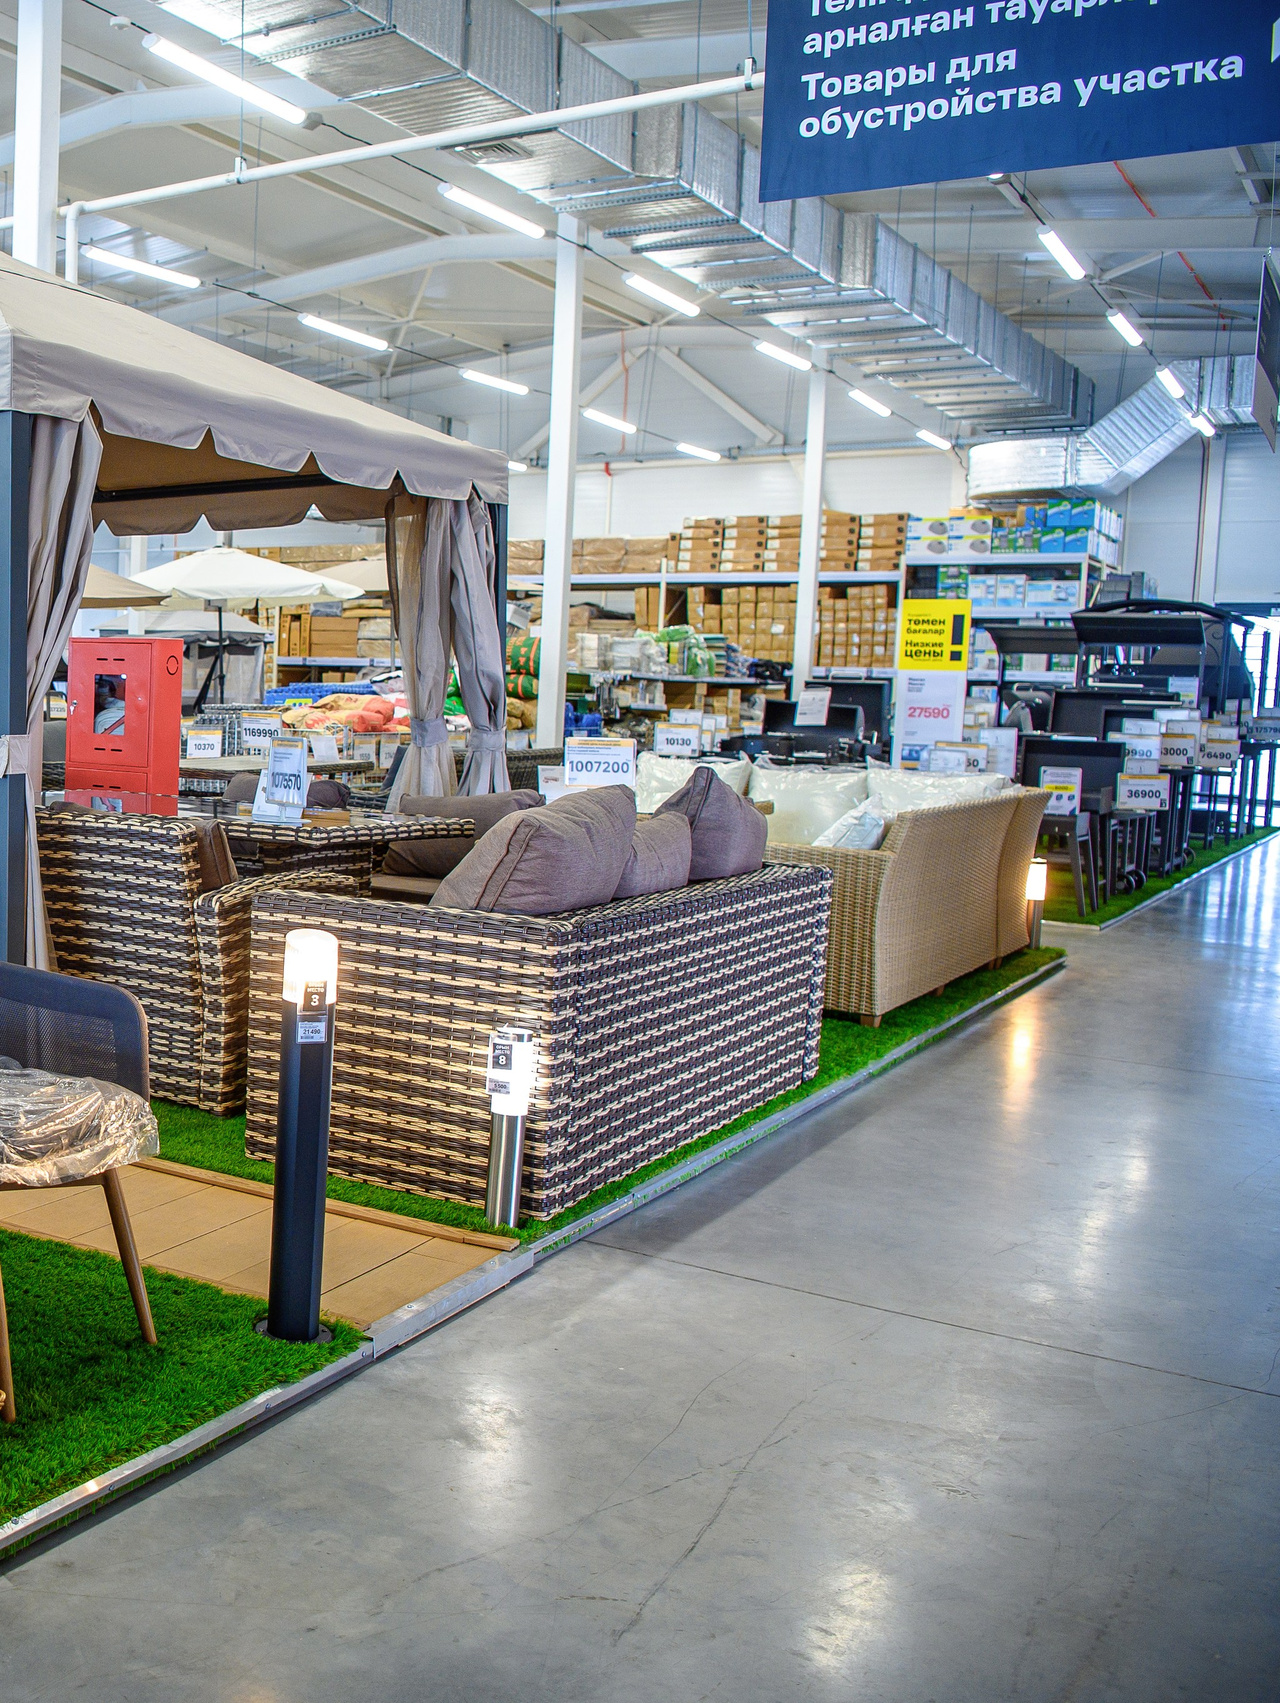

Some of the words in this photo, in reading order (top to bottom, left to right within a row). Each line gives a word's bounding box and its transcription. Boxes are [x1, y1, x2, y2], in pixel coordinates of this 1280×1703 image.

[802, 6, 974, 58] арналған
[984, 0, 1158, 25] тауар
[800, 61, 936, 101] Товары
[945, 48, 1017, 84] для
[798, 80, 1062, 140] обустройства
[1073, 54, 1244, 108] участка
[907, 618, 946, 626] төмен
[905, 640, 944, 648] Низкие
[904, 648, 944, 659] цены
[907, 706, 950, 719] 27590
[244, 727, 279, 737] 1169990
[665, 737, 692, 746] 10130
[569, 760, 630, 773] 1007200
[1127, 789, 1161, 799] 36900
[311, 995, 320, 1006] 3
[498, 1055, 507, 1065] 8
